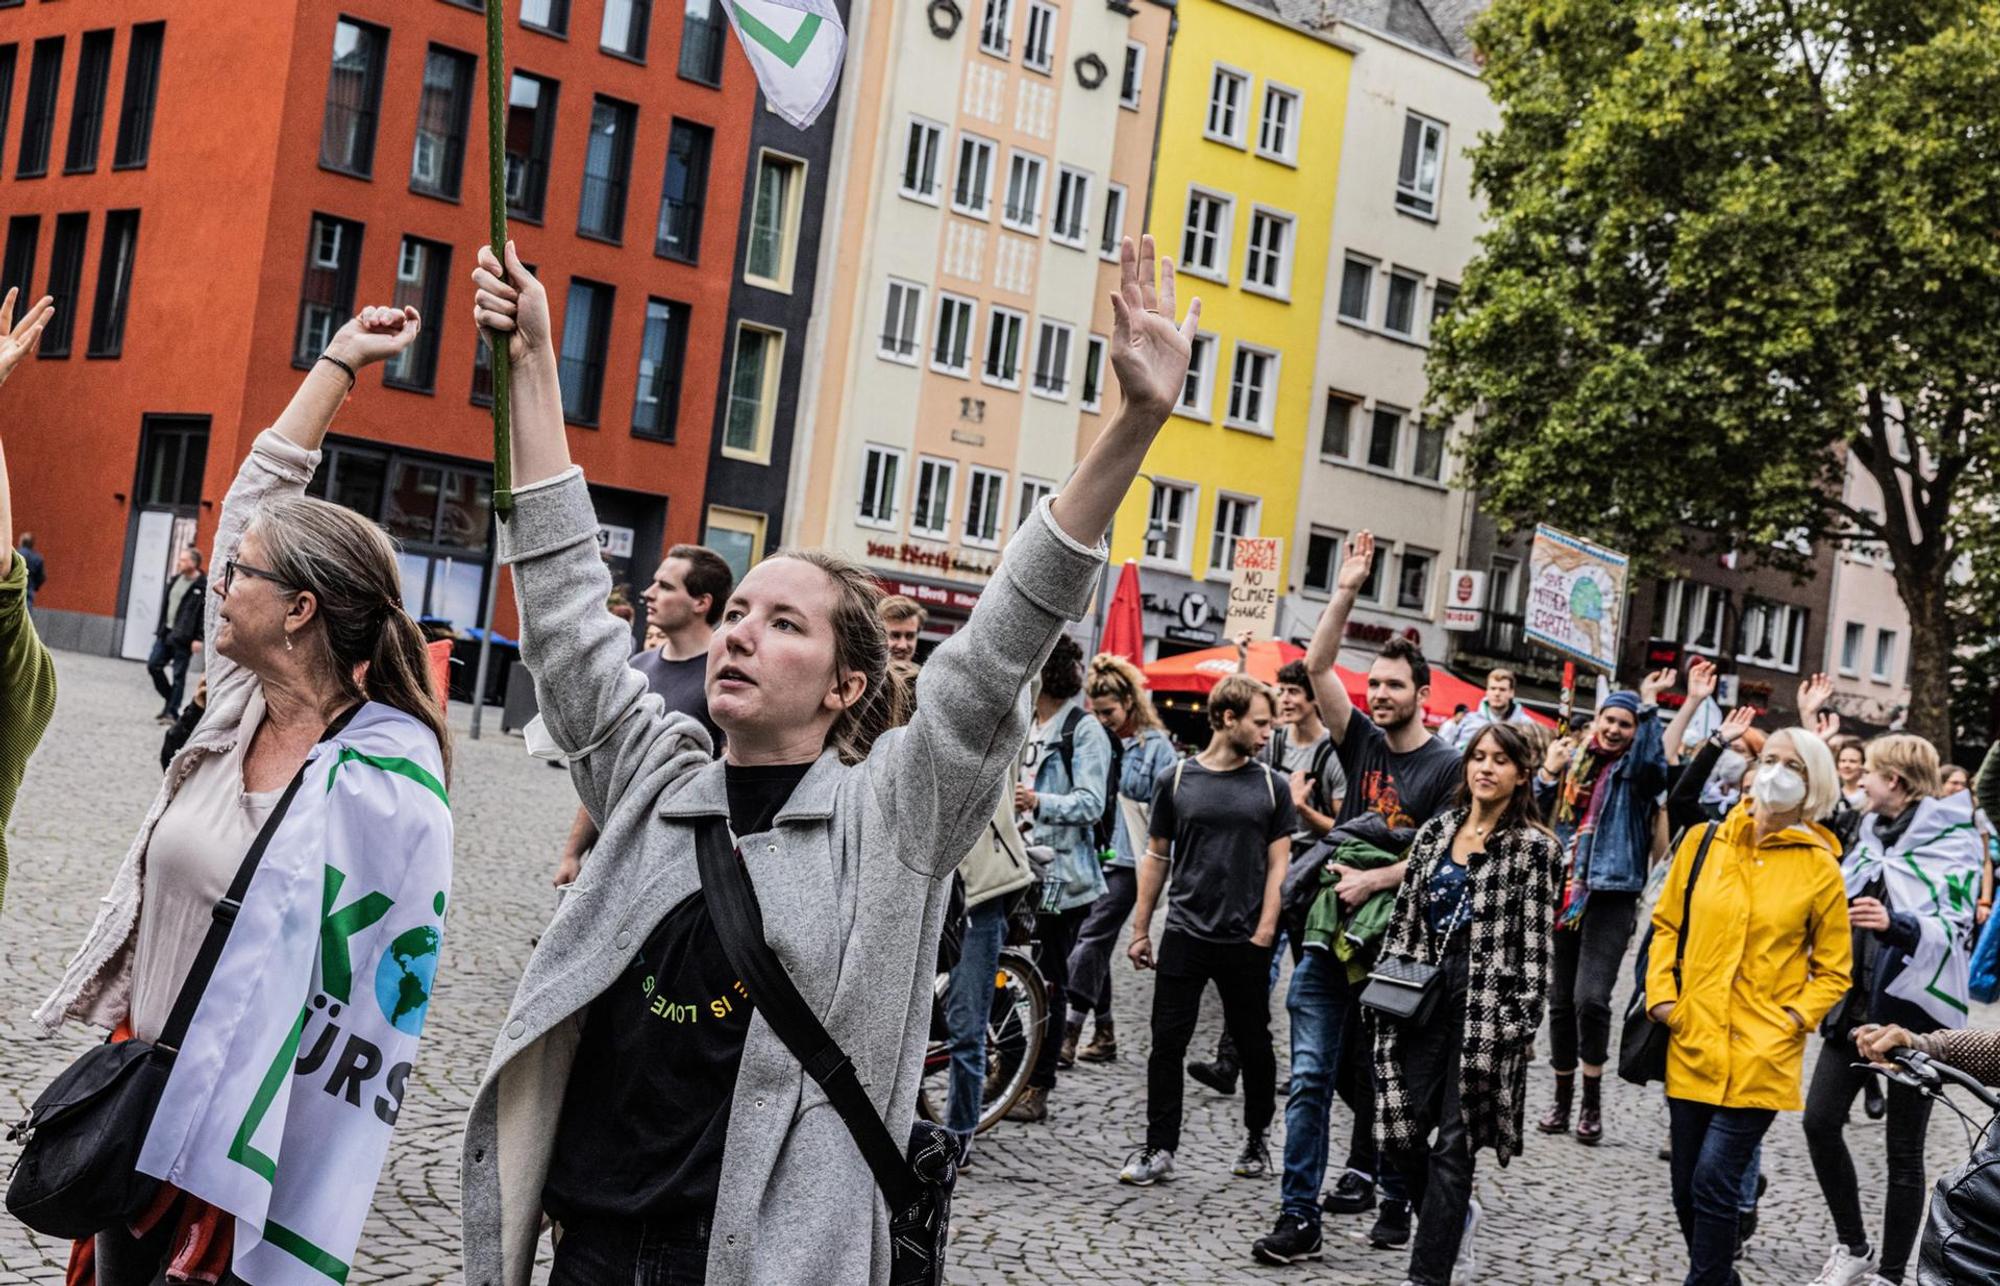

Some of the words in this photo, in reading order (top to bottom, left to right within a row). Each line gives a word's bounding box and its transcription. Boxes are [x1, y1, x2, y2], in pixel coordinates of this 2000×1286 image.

[1244, 571, 1262, 586] NO
[1231, 587, 1275, 603] CLIMATE
[1228, 605, 1268, 620] CHANGE
[650, 994, 697, 1024] LOVE
